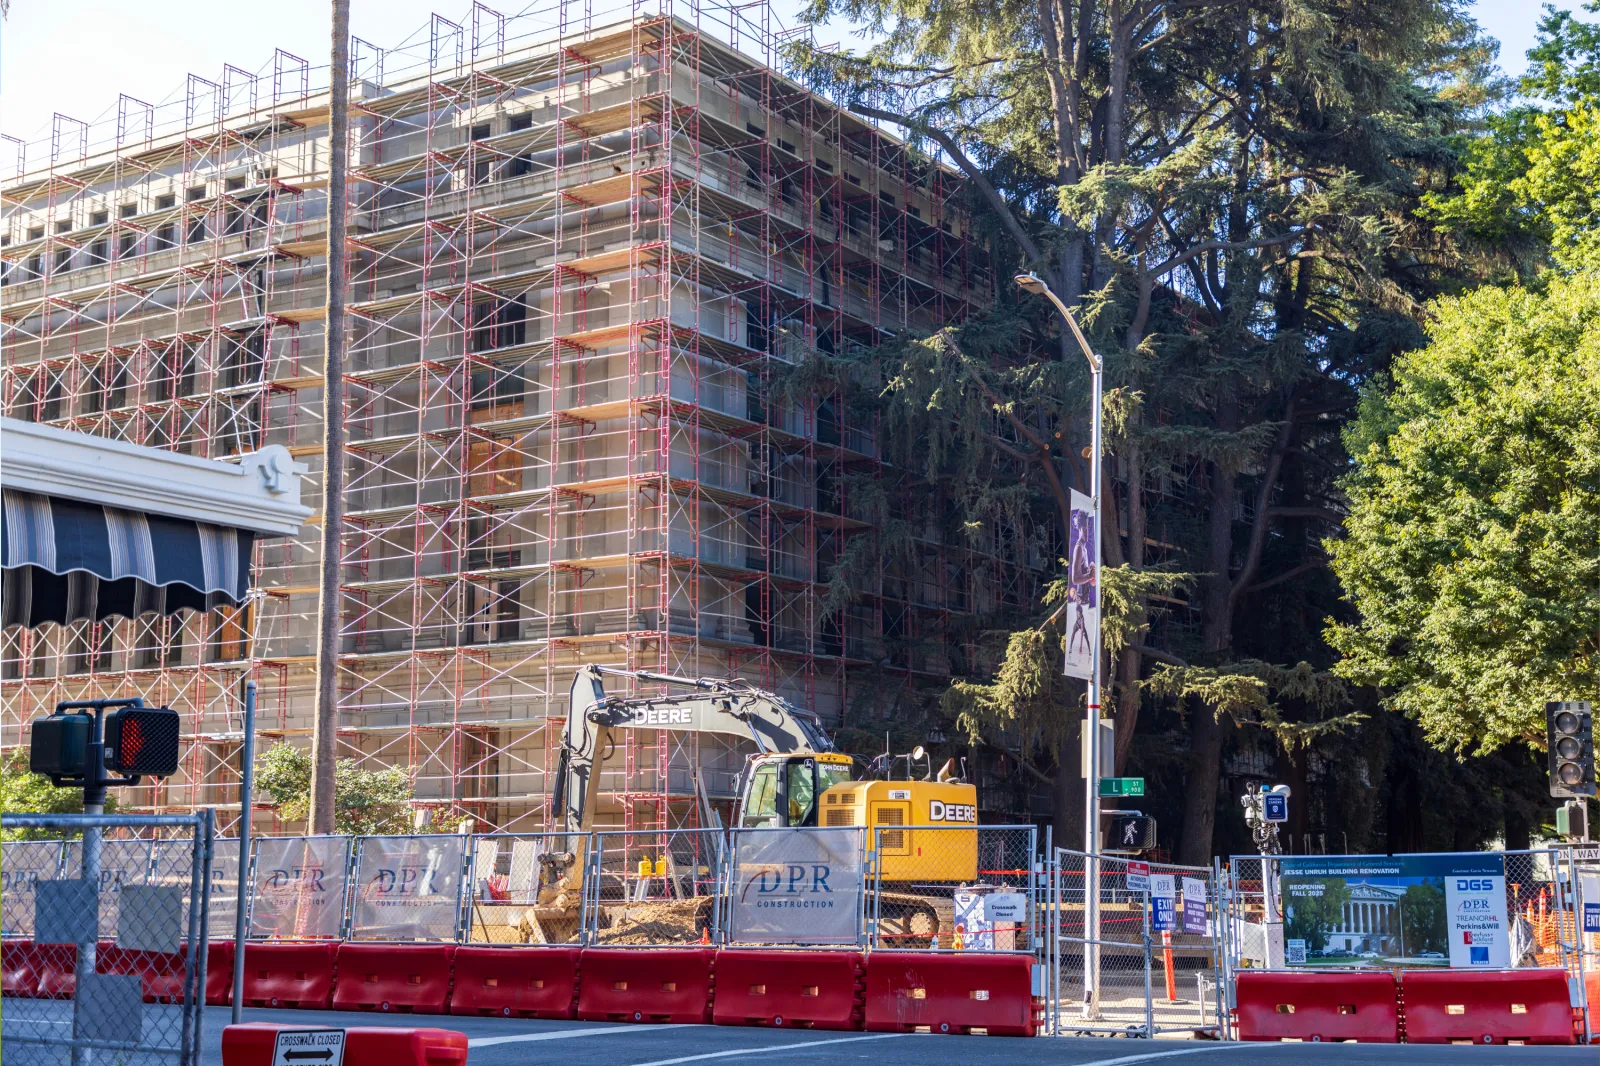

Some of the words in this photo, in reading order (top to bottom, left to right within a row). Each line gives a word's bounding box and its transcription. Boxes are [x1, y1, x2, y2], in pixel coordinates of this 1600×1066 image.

[634, 707, 692, 725] DEERE
[1112, 782, 1118, 792] L
[930, 800, 976, 822] DEERE
[1577, 849, 1599, 859] WAY
[1327, 860, 1355, 869] Department
[377, 868, 439, 893] DPR
[757, 865, 834, 893] DPR
[1456, 879, 1494, 891] DGS
[757, 900, 834, 908] CONSTRUCTION
[1157, 899, 1173, 910] EXIT
[1463, 899, 1490, 909] DPR
[1158, 910, 1174, 922] ONLY
[1456, 914, 1499, 922] TREANORHL
[280, 1035, 316, 1047] CROSSWALK
[317, 1034, 341, 1046] CLOSED
